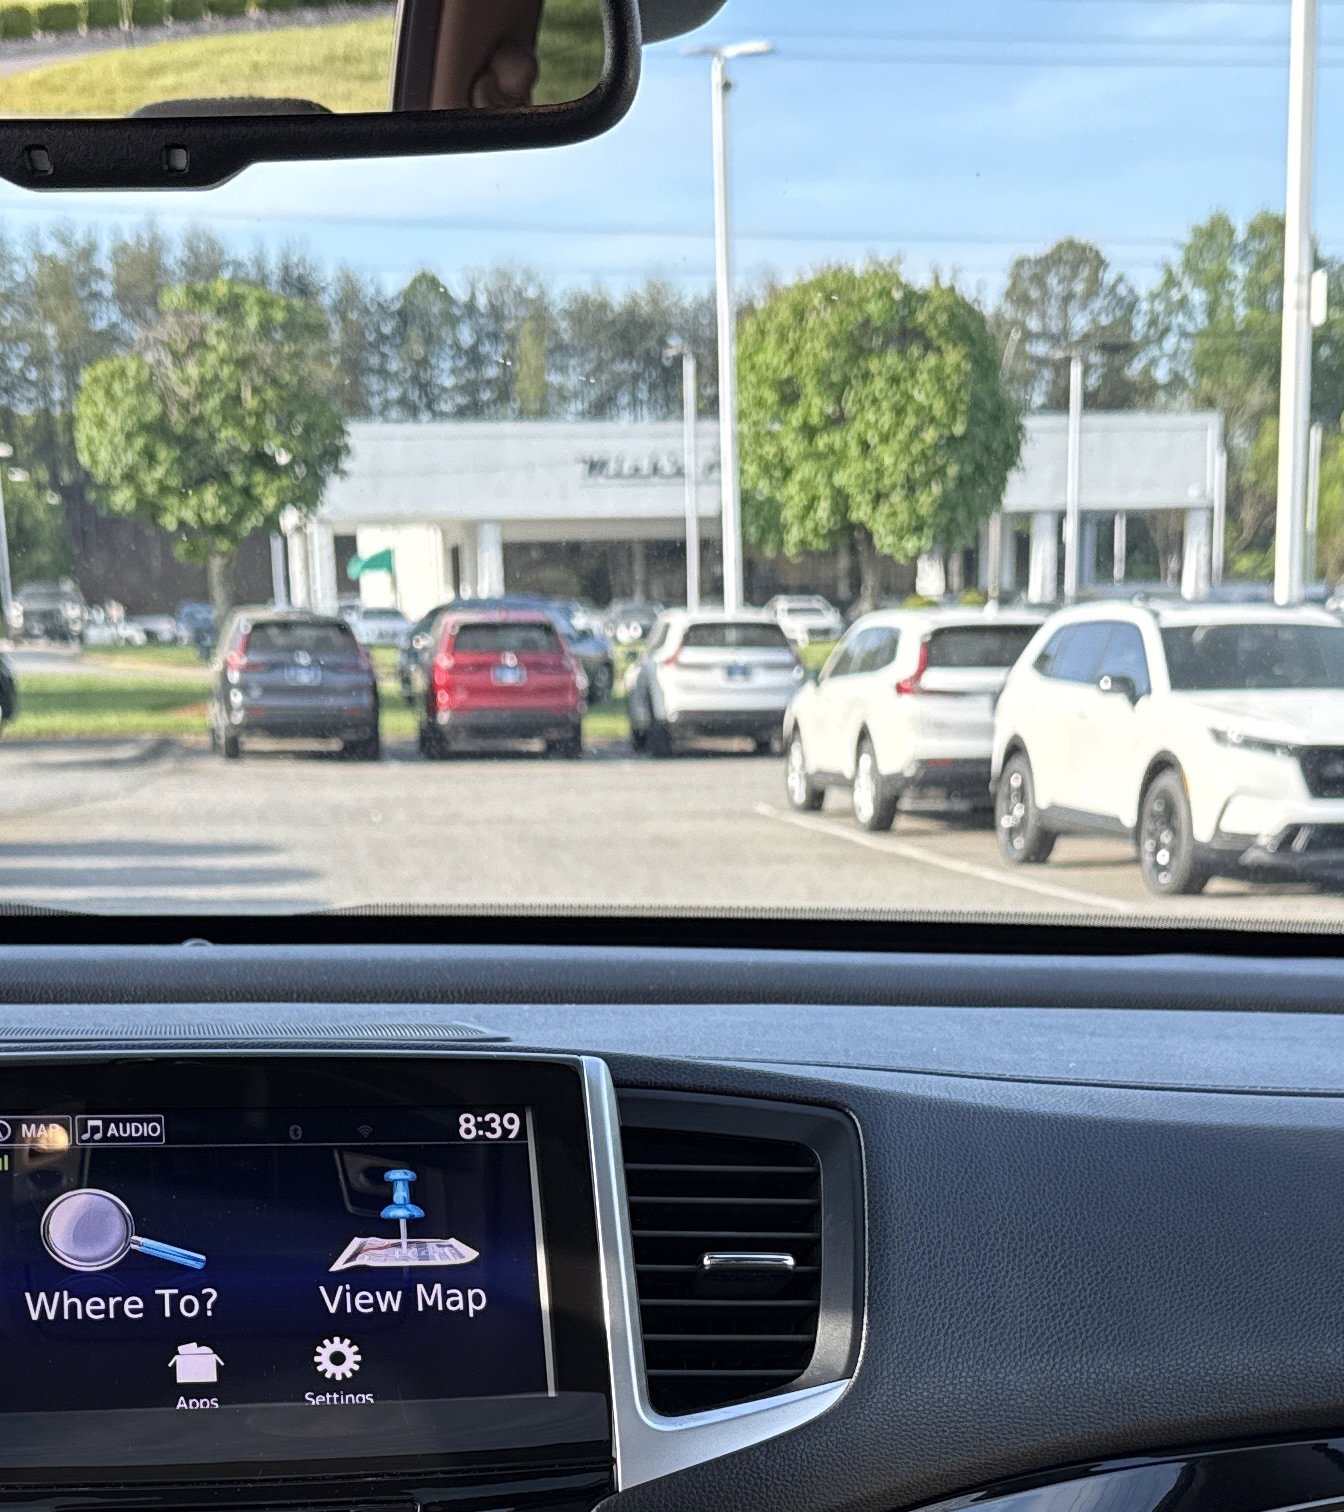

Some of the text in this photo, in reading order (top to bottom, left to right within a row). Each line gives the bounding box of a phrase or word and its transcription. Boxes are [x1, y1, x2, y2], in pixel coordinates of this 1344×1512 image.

[21, 1122, 61, 1139] MAP
[106, 1122, 161, 1138] AUDIO
[458, 1112, 520, 1139] 8:39
[24, 1287, 218, 1320] Where To?
[318, 1283, 487, 1318] View Map
